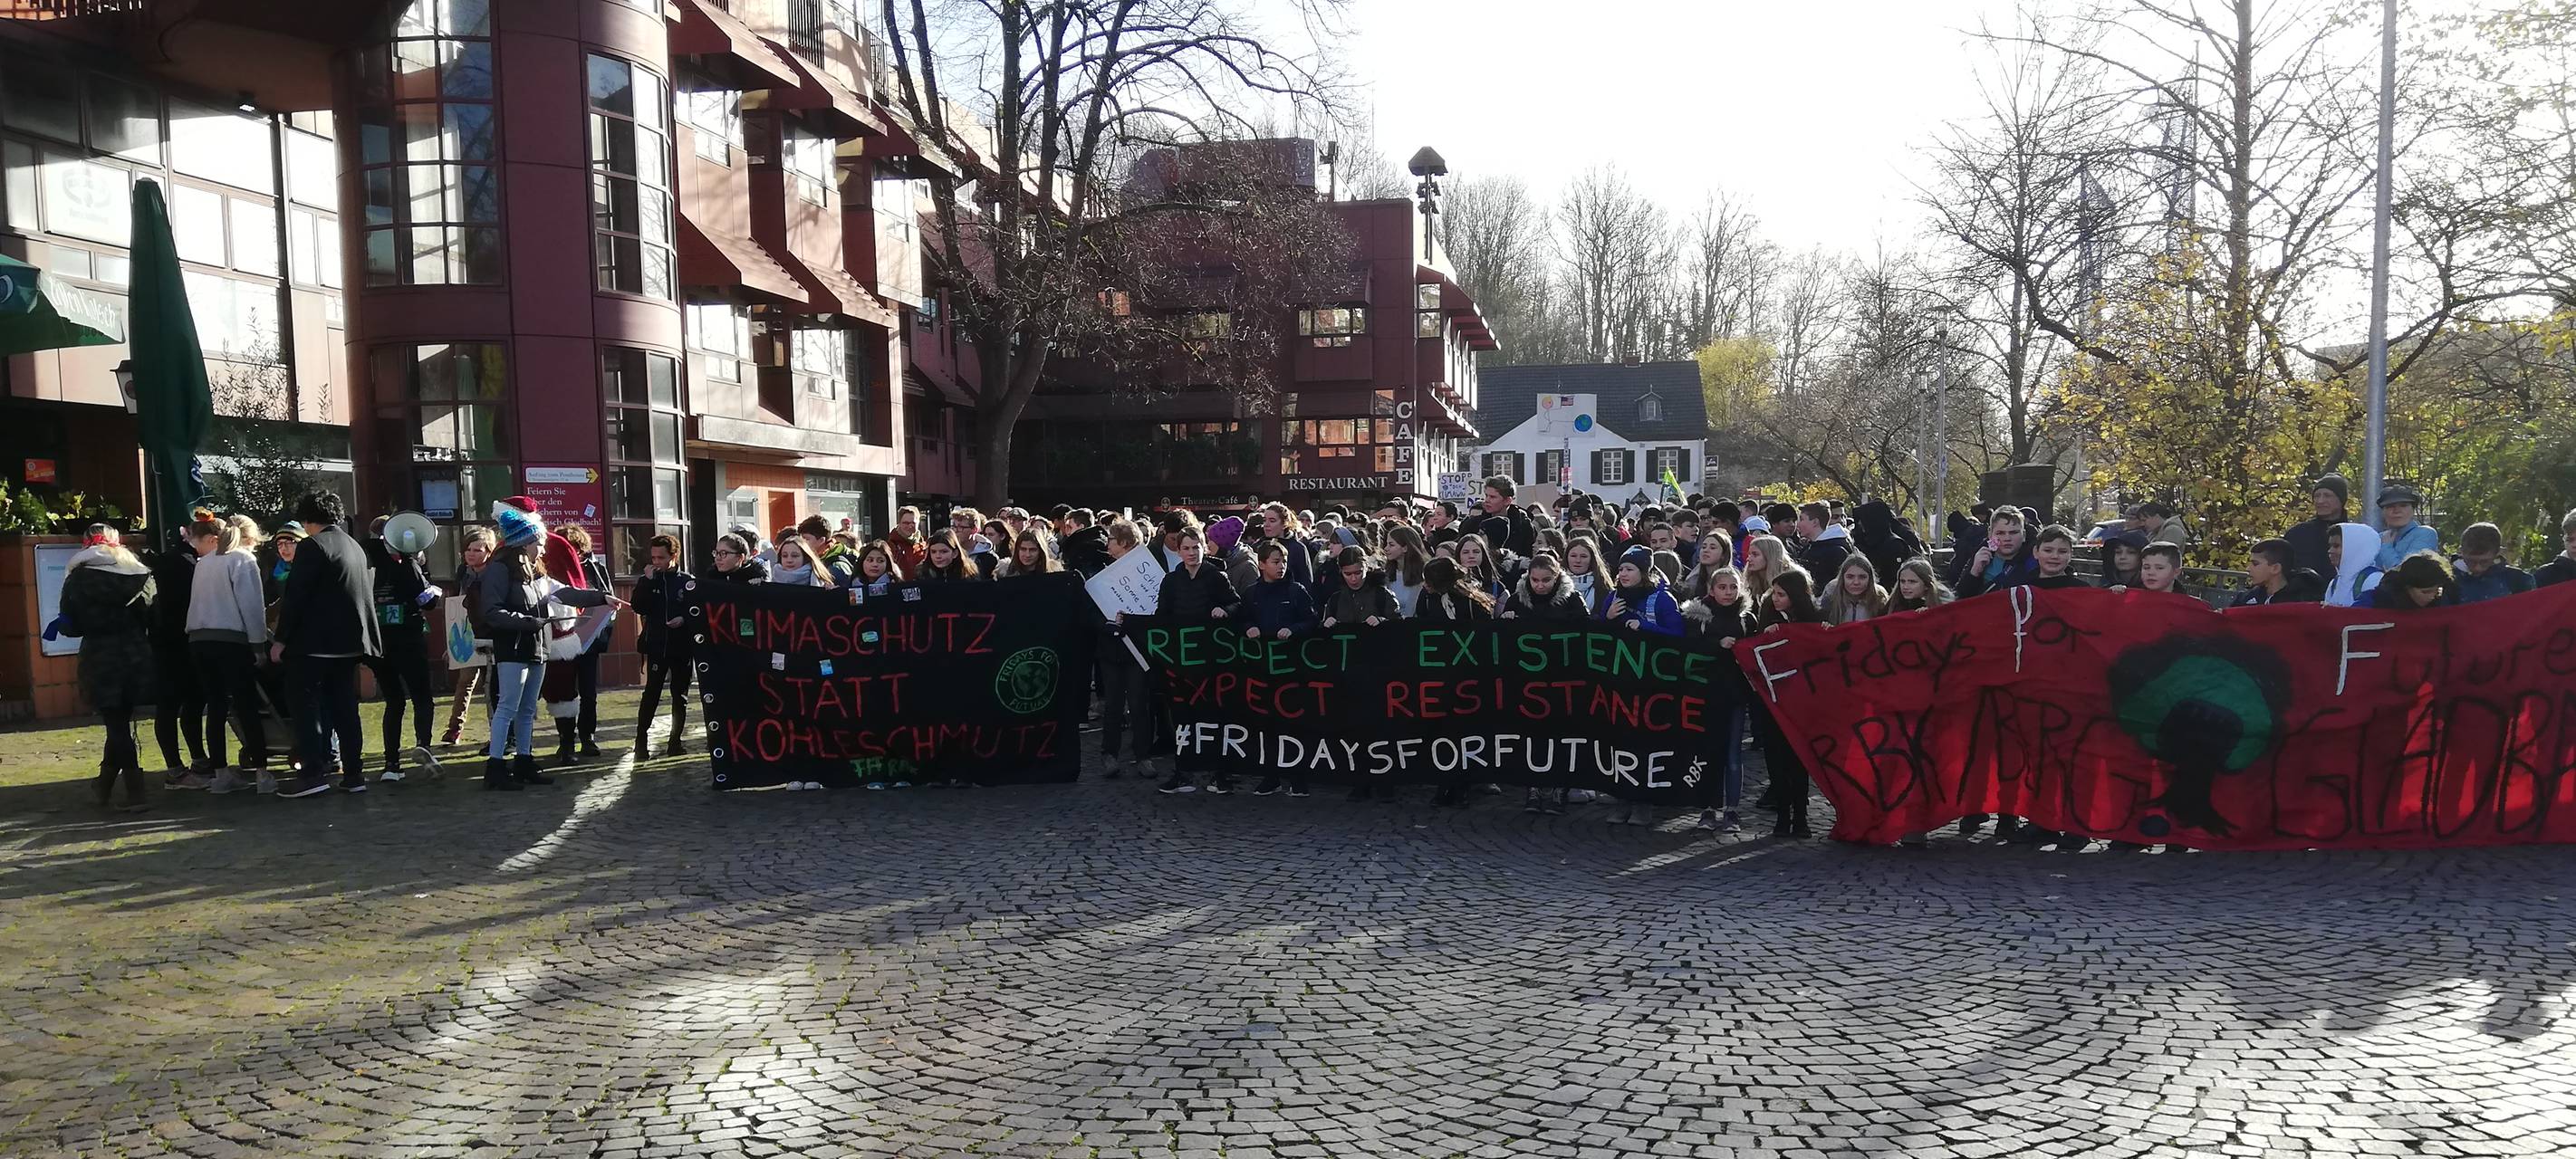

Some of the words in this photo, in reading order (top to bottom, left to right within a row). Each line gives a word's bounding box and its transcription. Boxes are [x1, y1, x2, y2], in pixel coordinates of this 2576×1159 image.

[1396, 401, 1414, 484] CAFE
[527, 487, 553, 495] Feiern
[553, 487, 566, 495] Sie
[533, 497, 545, 505] ber
[547, 497, 562, 505] den
[1289, 476, 1389, 490] RESTAURANT
[1468, 480, 1484, 495] ST
[1119, 575, 1139, 603] Sonne
[706, 602, 995, 656] KLIMASCHUTZ
[1419, 630, 1716, 684] EXISTENCE
[1754, 627, 1976, 703] Fridays
[2335, 622, 2576, 695] Future
[759, 672, 908, 719] STATT
[1386, 677, 1706, 732] RESISTANCE
[727, 719, 1058, 762] KOHLESCHMUTZ
[1176, 723, 1674, 788] #FRIDAYSFORFUTURE
[1683, 755, 1708, 788] RBK
